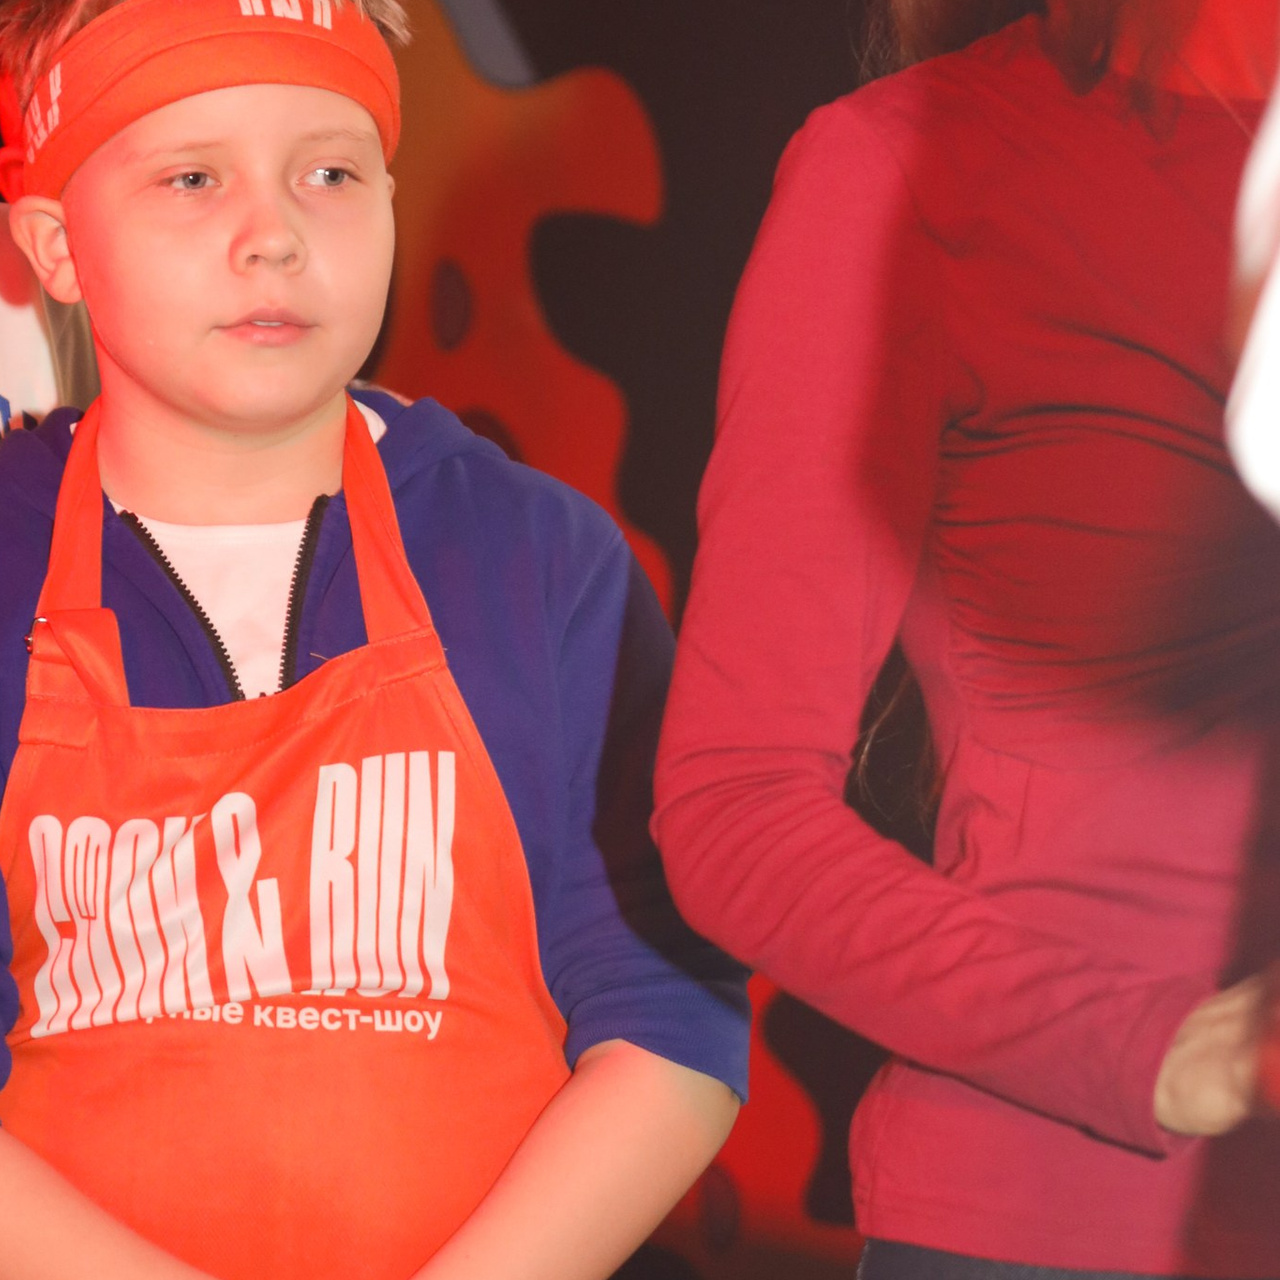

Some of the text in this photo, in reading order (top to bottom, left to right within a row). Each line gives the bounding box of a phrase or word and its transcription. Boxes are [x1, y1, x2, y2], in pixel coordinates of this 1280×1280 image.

[28, 750, 456, 1038] COOK & RUN
[253, 1004, 443, 1041] квест-шоу
